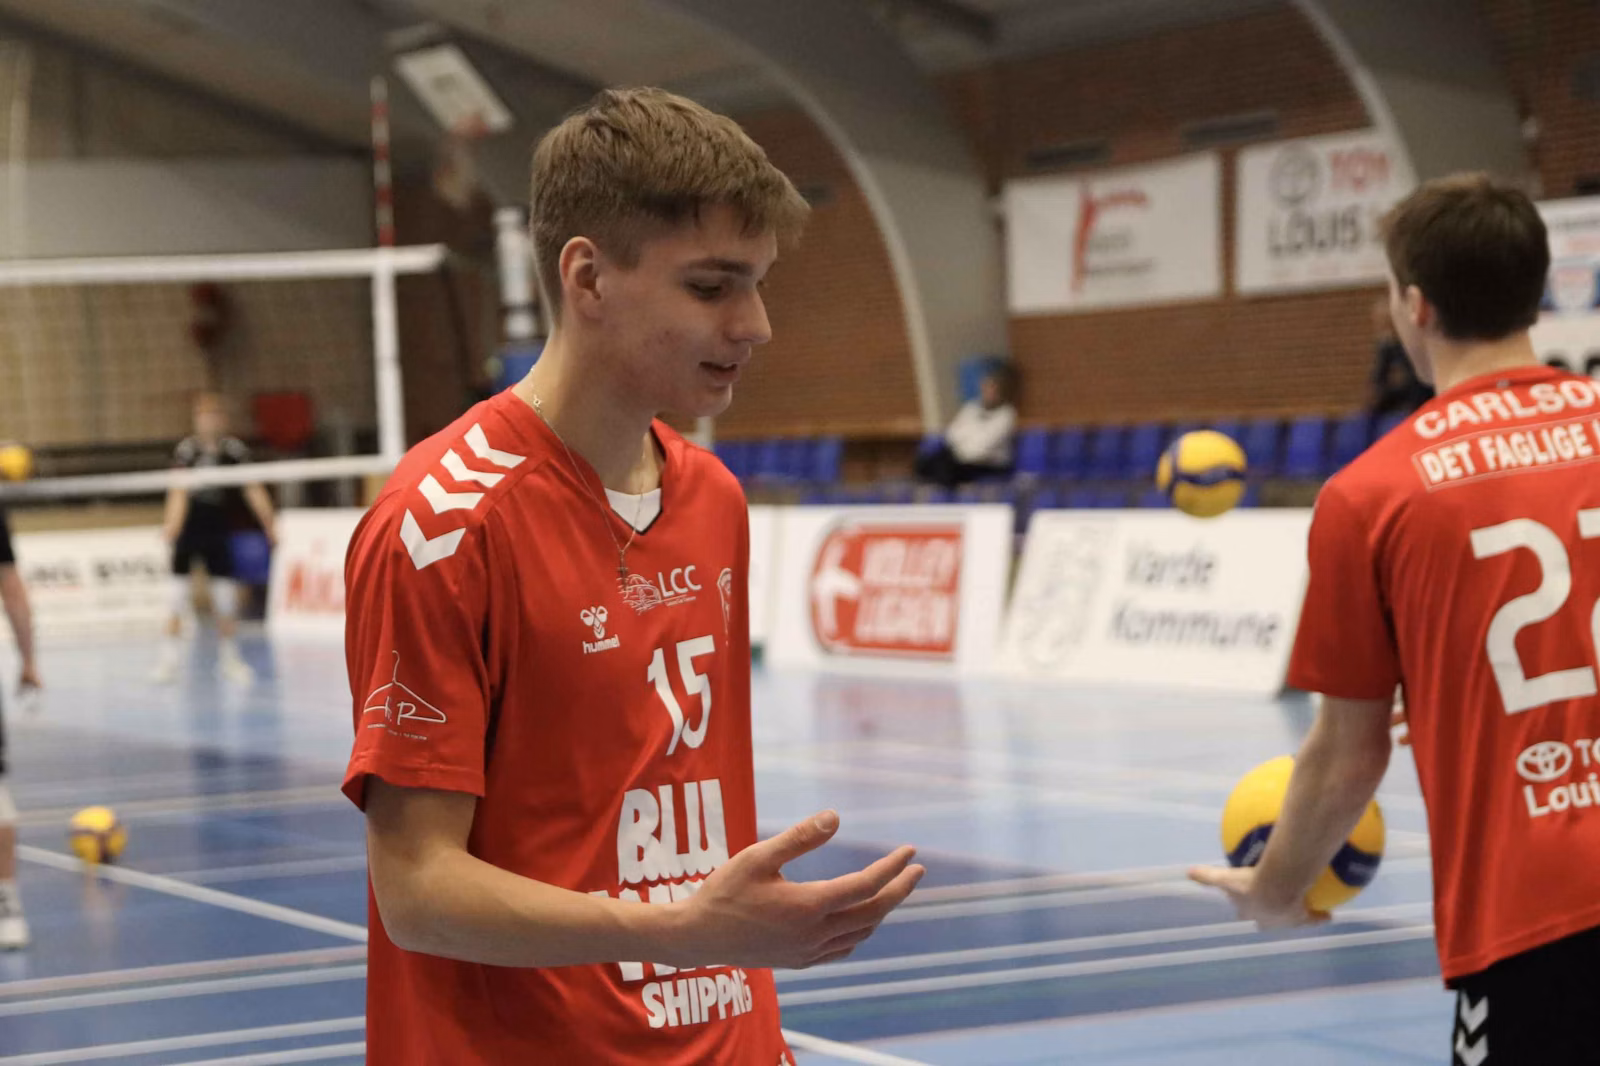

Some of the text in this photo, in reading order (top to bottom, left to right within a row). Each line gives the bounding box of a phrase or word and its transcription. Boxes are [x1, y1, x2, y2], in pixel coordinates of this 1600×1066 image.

[1420, 441, 1476, 483] DET
[1478, 422, 1593, 470] FAGLIGE
[657, 564, 702, 597] LCC
[582, 634, 621, 654] hummel
[1110, 601, 1281, 648] Kommune
[647, 634, 716, 756] 15
